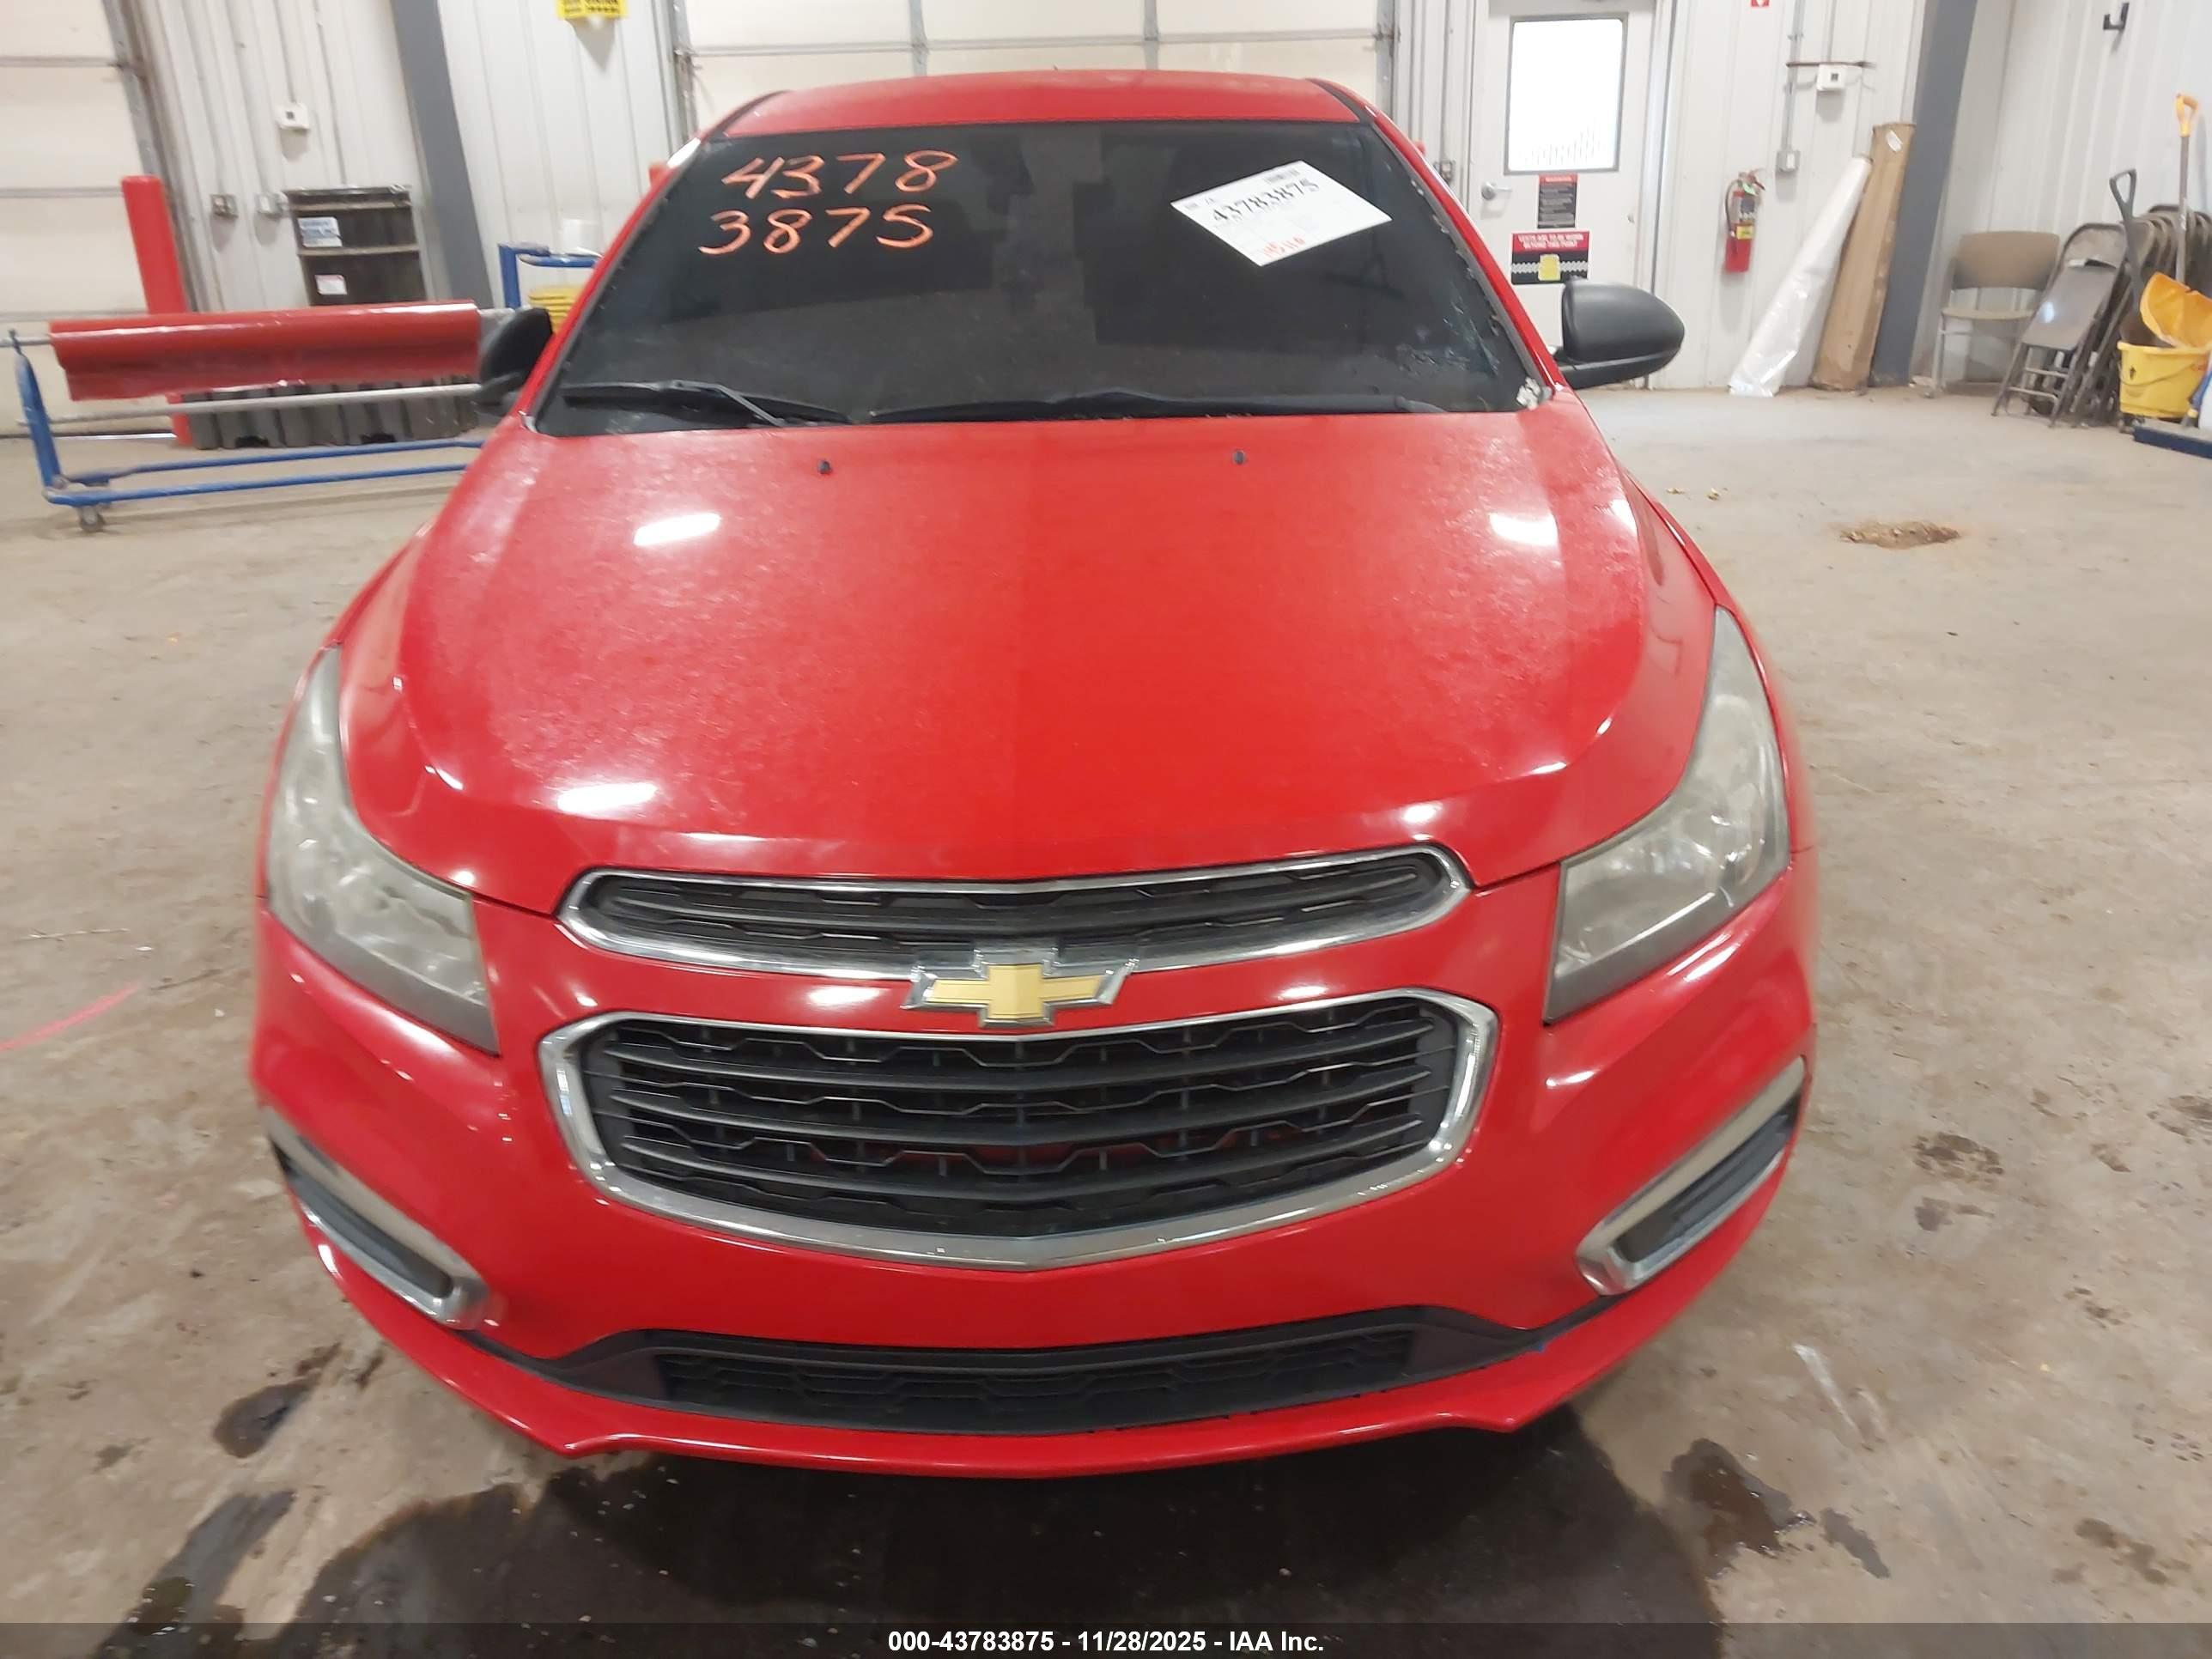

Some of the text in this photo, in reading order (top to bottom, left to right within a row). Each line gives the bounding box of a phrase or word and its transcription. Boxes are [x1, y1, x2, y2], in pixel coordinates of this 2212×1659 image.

[721, 149, 958, 199] 4378
[1212, 178, 1320, 221] 43783875
[697, 203, 934, 254] 3875
